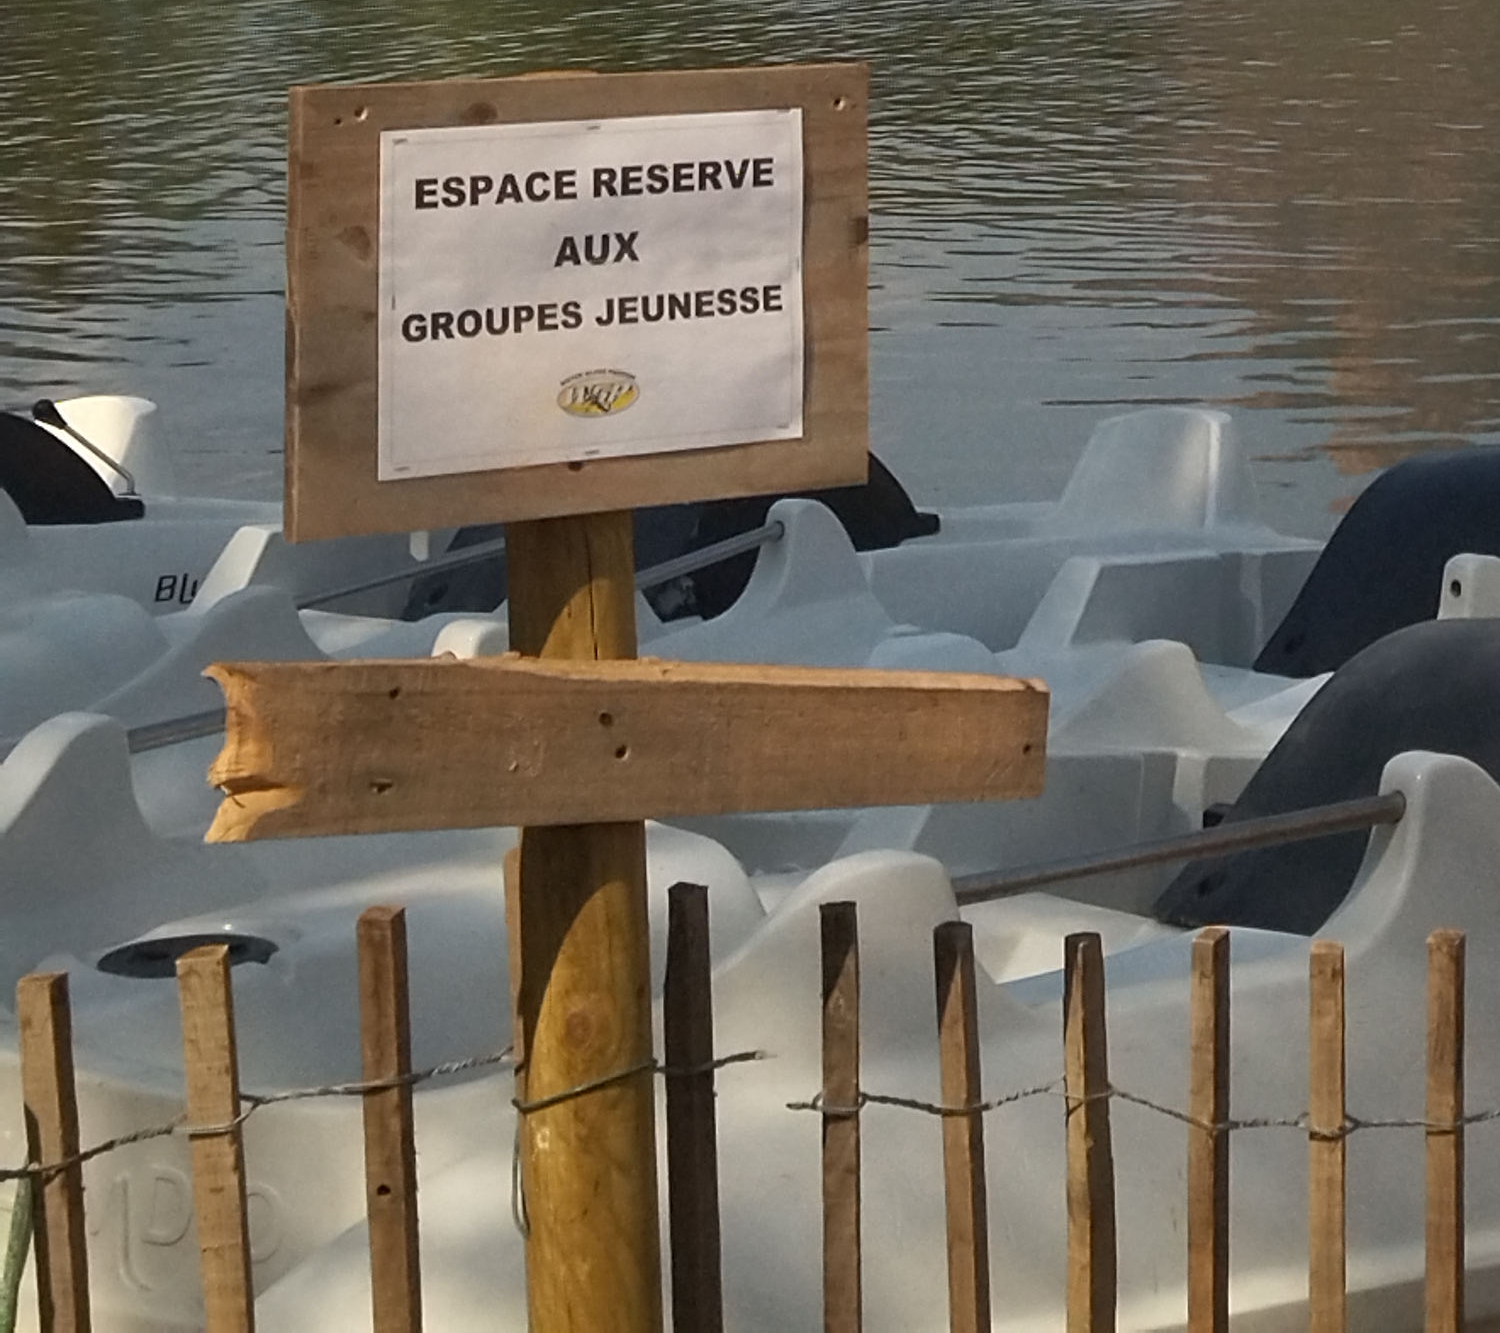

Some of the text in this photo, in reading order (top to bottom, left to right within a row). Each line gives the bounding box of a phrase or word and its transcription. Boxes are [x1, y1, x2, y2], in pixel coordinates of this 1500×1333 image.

[416, 157, 774, 209] ESPACE RESERVE
[553, 230, 639, 268] AUX
[401, 284, 783, 343] GROUPES JEUNESSE
